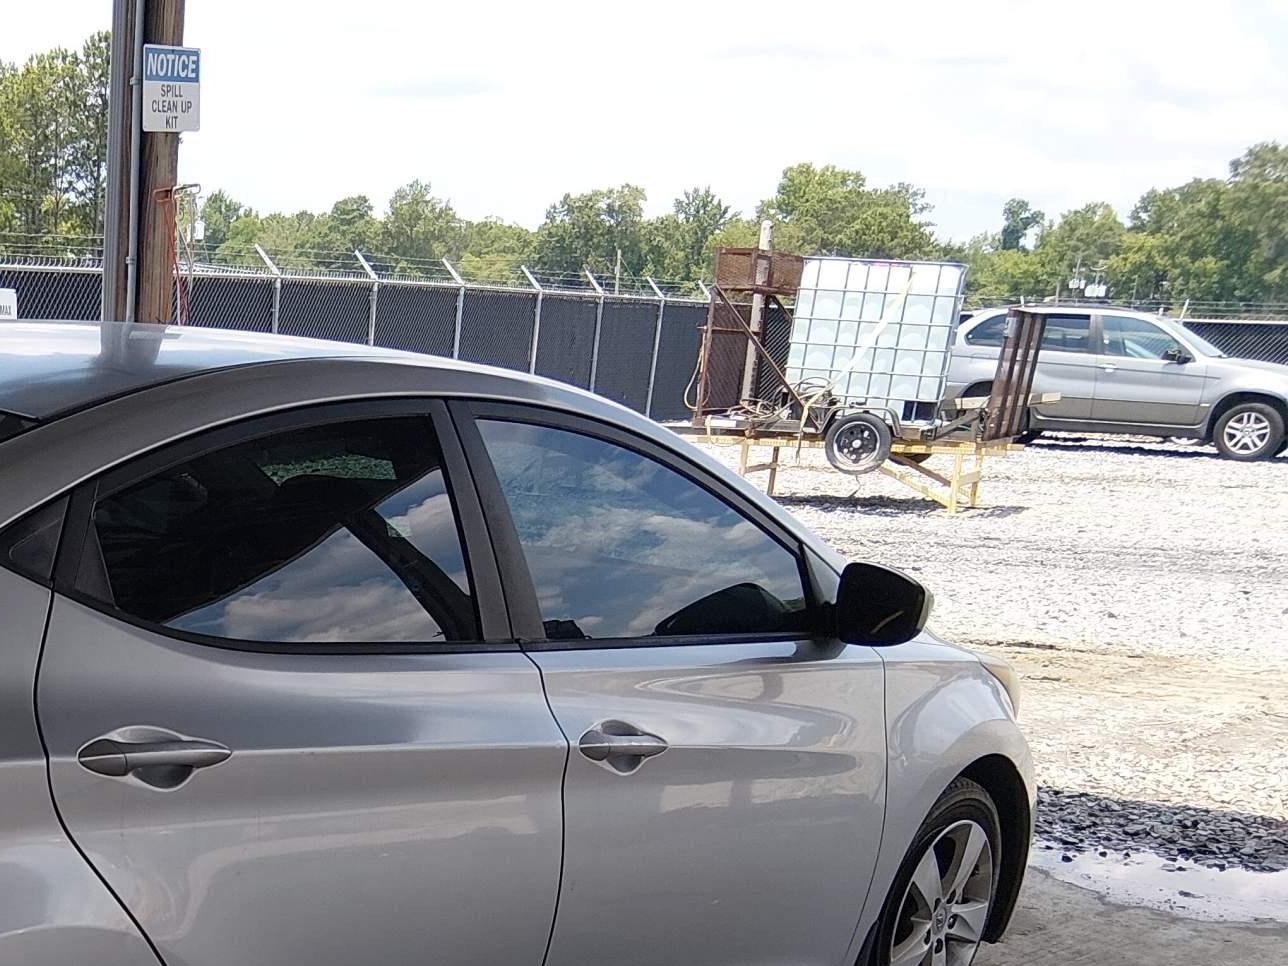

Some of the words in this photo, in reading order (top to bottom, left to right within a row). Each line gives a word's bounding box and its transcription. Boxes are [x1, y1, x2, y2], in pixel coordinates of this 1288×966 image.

[147, 53, 197, 77] NOTICE
[161, 84, 183, 97] SPILL
[152, 100, 177, 113] CLEAN
[181, 101, 192, 113] UP
[165, 116, 178, 128] KIT
